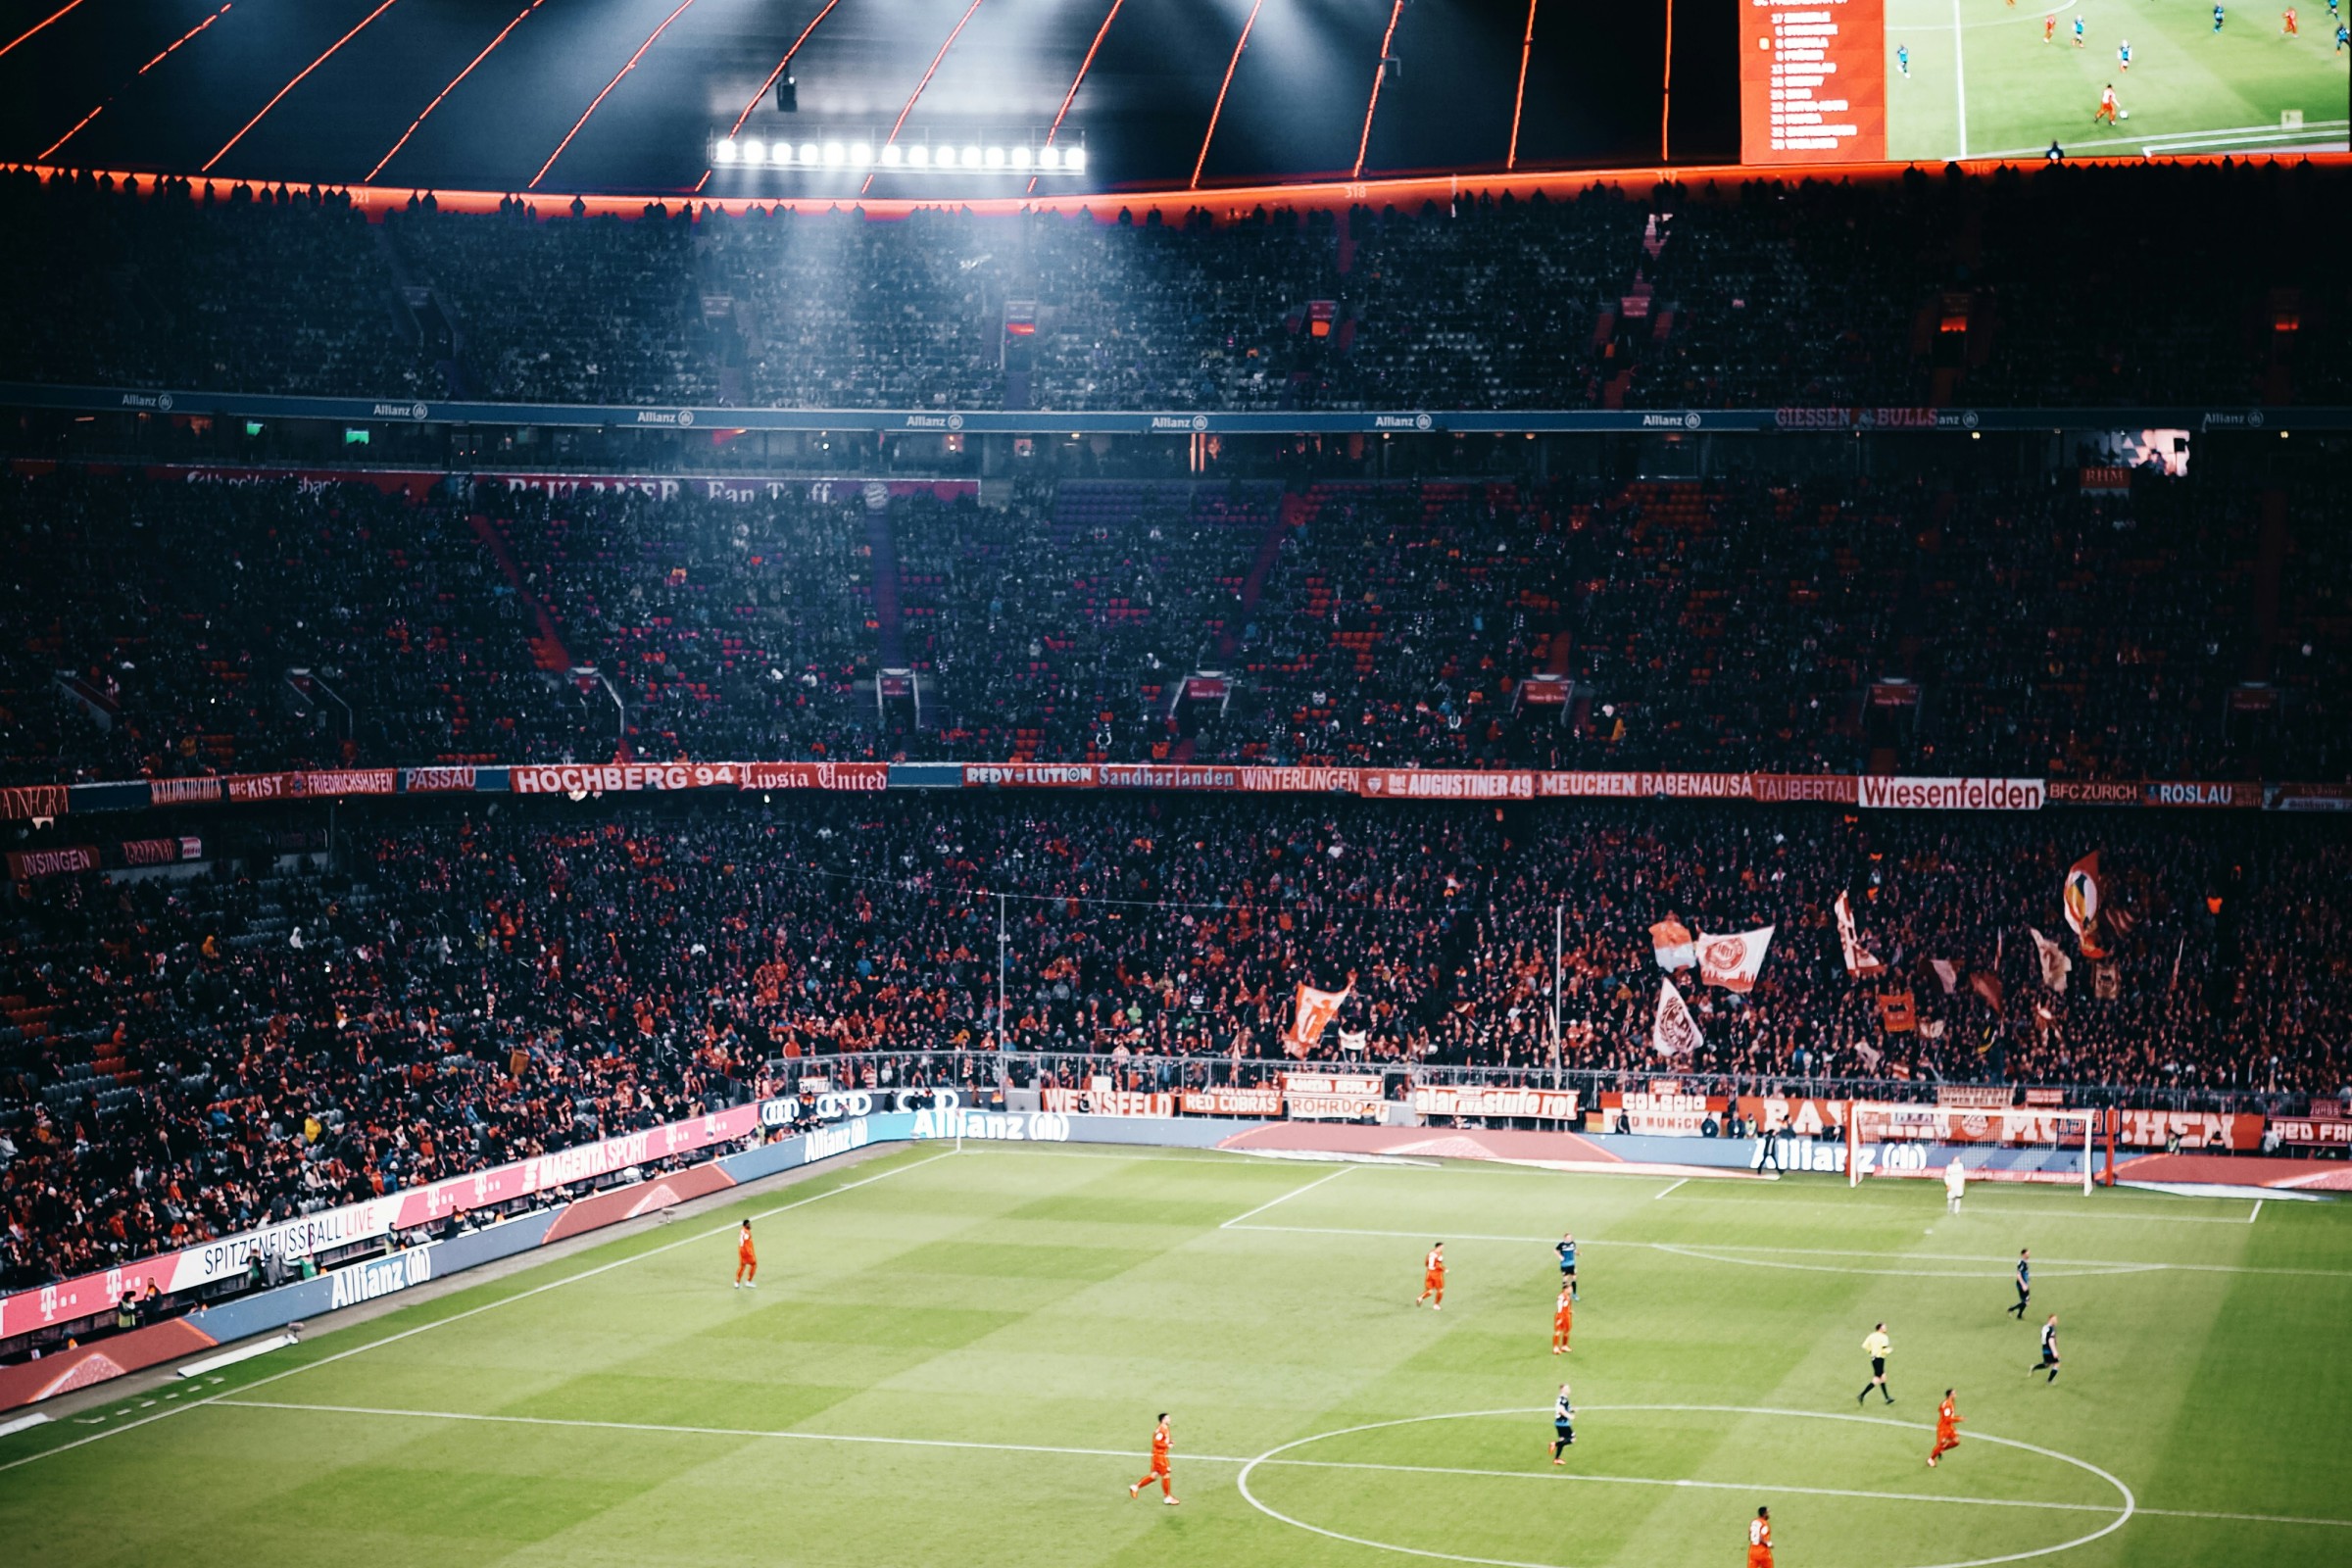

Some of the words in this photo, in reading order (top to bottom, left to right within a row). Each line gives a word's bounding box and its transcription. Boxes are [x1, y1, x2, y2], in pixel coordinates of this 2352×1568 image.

[1345, 185, 1366, 199] 318
[122, 394, 157, 407] Allianz
[374, 404, 411, 417] Allianz
[638, 412, 675, 424] Allianz
[1775, 408, 1850, 427] GIESSEN
[1875, 408, 1937, 427] BULLS
[2204, 413, 2241, 425] Allianz
[906, 415, 946, 427] Allianz
[1152, 416, 1190, 428] Allianz
[1375, 416, 1413, 427] Allianz
[1643, 415, 1682, 426] Allianz
[247, 775, 283, 798] KIST
[308, 772, 393, 797] FRIEDRICHSHAFEN
[406, 769, 475, 788] PASSAU
[816, 764, 887, 791] United
[1099, 767, 1234, 787] Sandharlanden
[1408, 774, 1508, 797] AUGUSTINER
[1510, 776, 1532, 797] 49
[1543, 774, 1637, 796] MEUCHEN
[1758, 778, 1855, 802] TAUBERTAL
[1864, 777, 2039, 808] Wiesenfelden
[2049, 784, 2080, 799] BFC
[2082, 781, 2136, 800] ZÜRICH
[2161, 782, 2231, 804] RÖSLAU
[1045, 1089, 1172, 1117] WENSFELD
[1186, 1094, 1214, 1110] RED
[1219, 1096, 1277, 1112] COBRAS
[913, 1109, 1024, 1141] Allianz
[1612, 1116, 1639, 1128] RD
[2320, 1123, 2352, 1142] FA
[805, 1127, 851, 1163] Allianz
[540, 1147, 607, 1186] MAGENTA
[608, 1134, 650, 1166] SPORT
[345, 1206, 374, 1237] LIVE
[331, 1256, 404, 1310] Allianz
